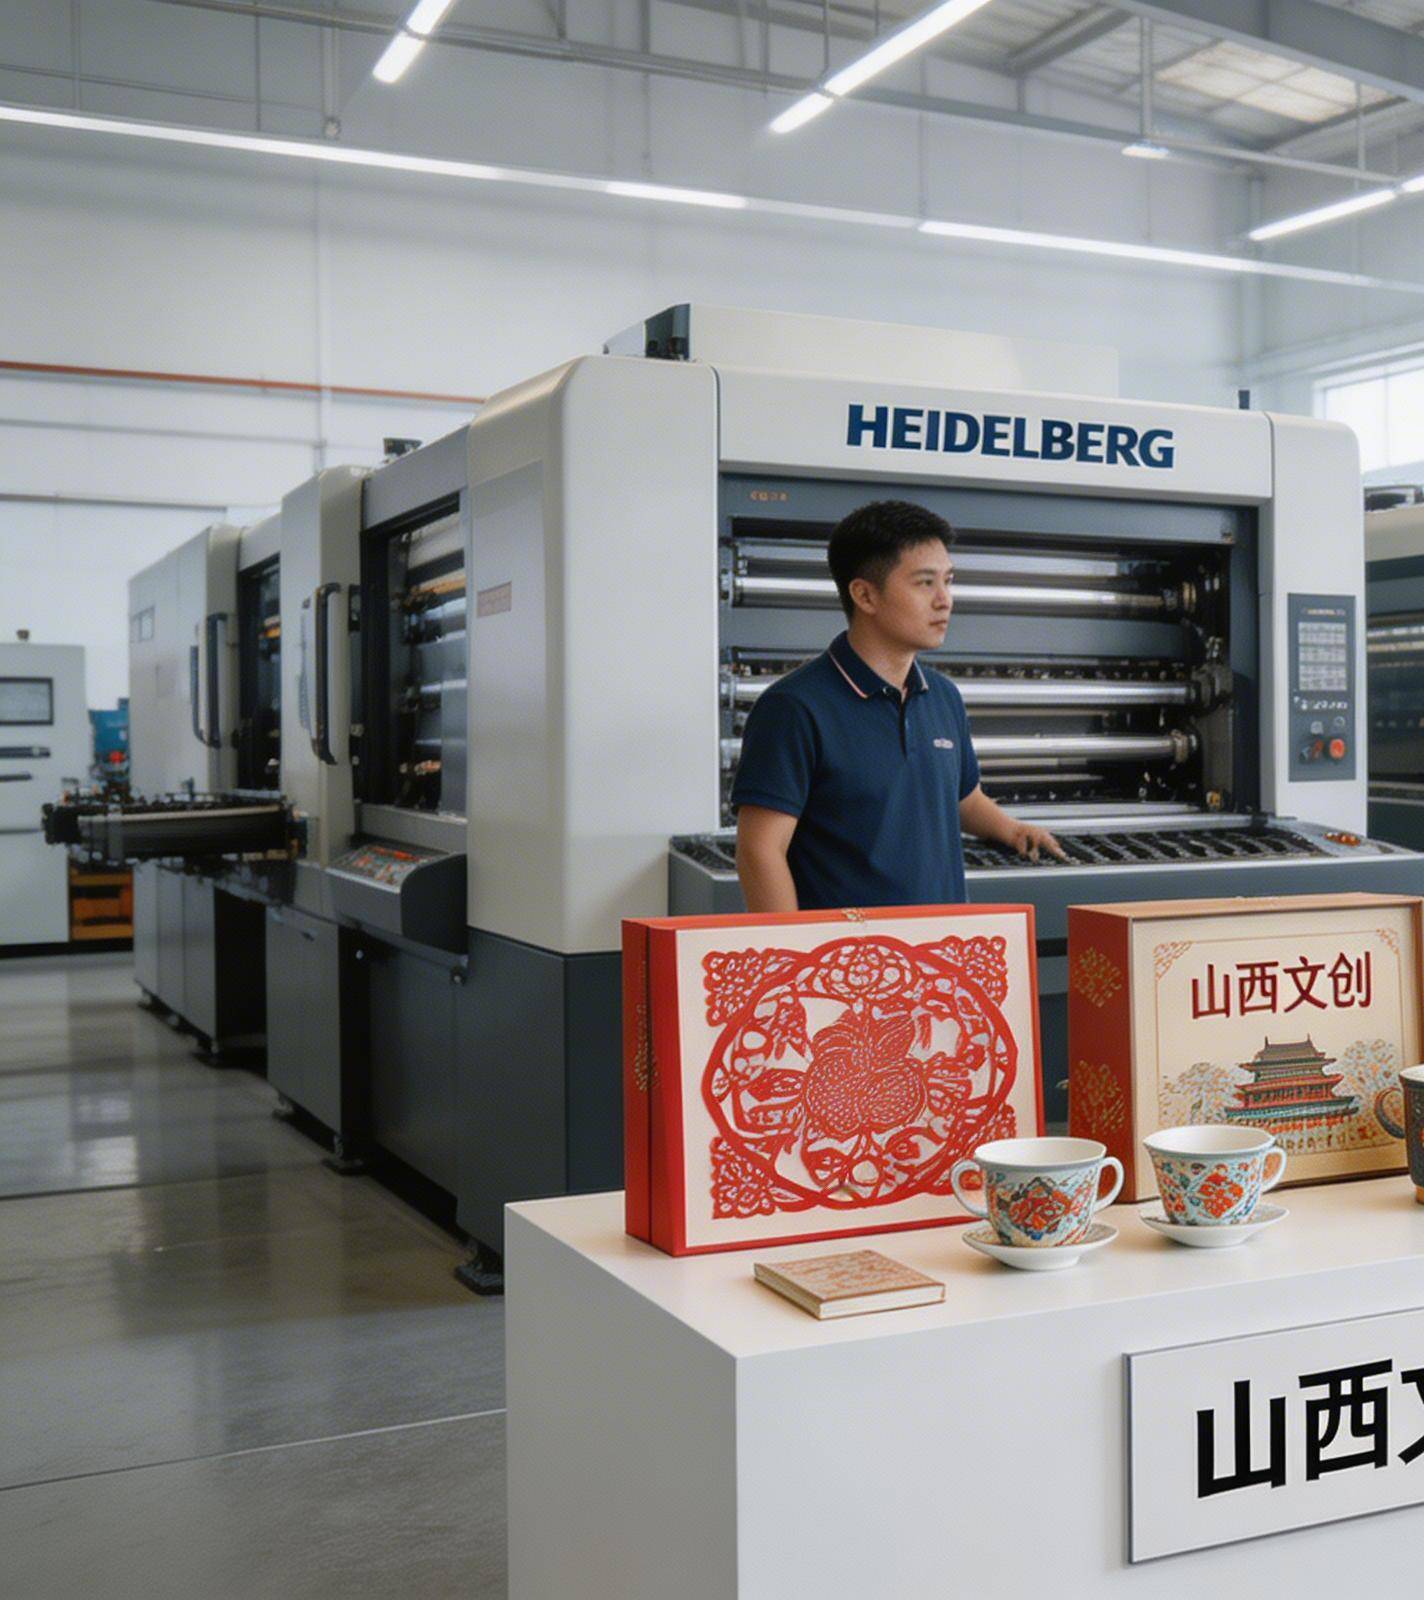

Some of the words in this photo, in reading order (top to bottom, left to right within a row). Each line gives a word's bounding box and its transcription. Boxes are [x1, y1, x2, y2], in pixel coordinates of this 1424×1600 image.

[846, 404, 1174, 469] HEIDELBERG
[1191, 951, 1372, 1020] 山西文创
